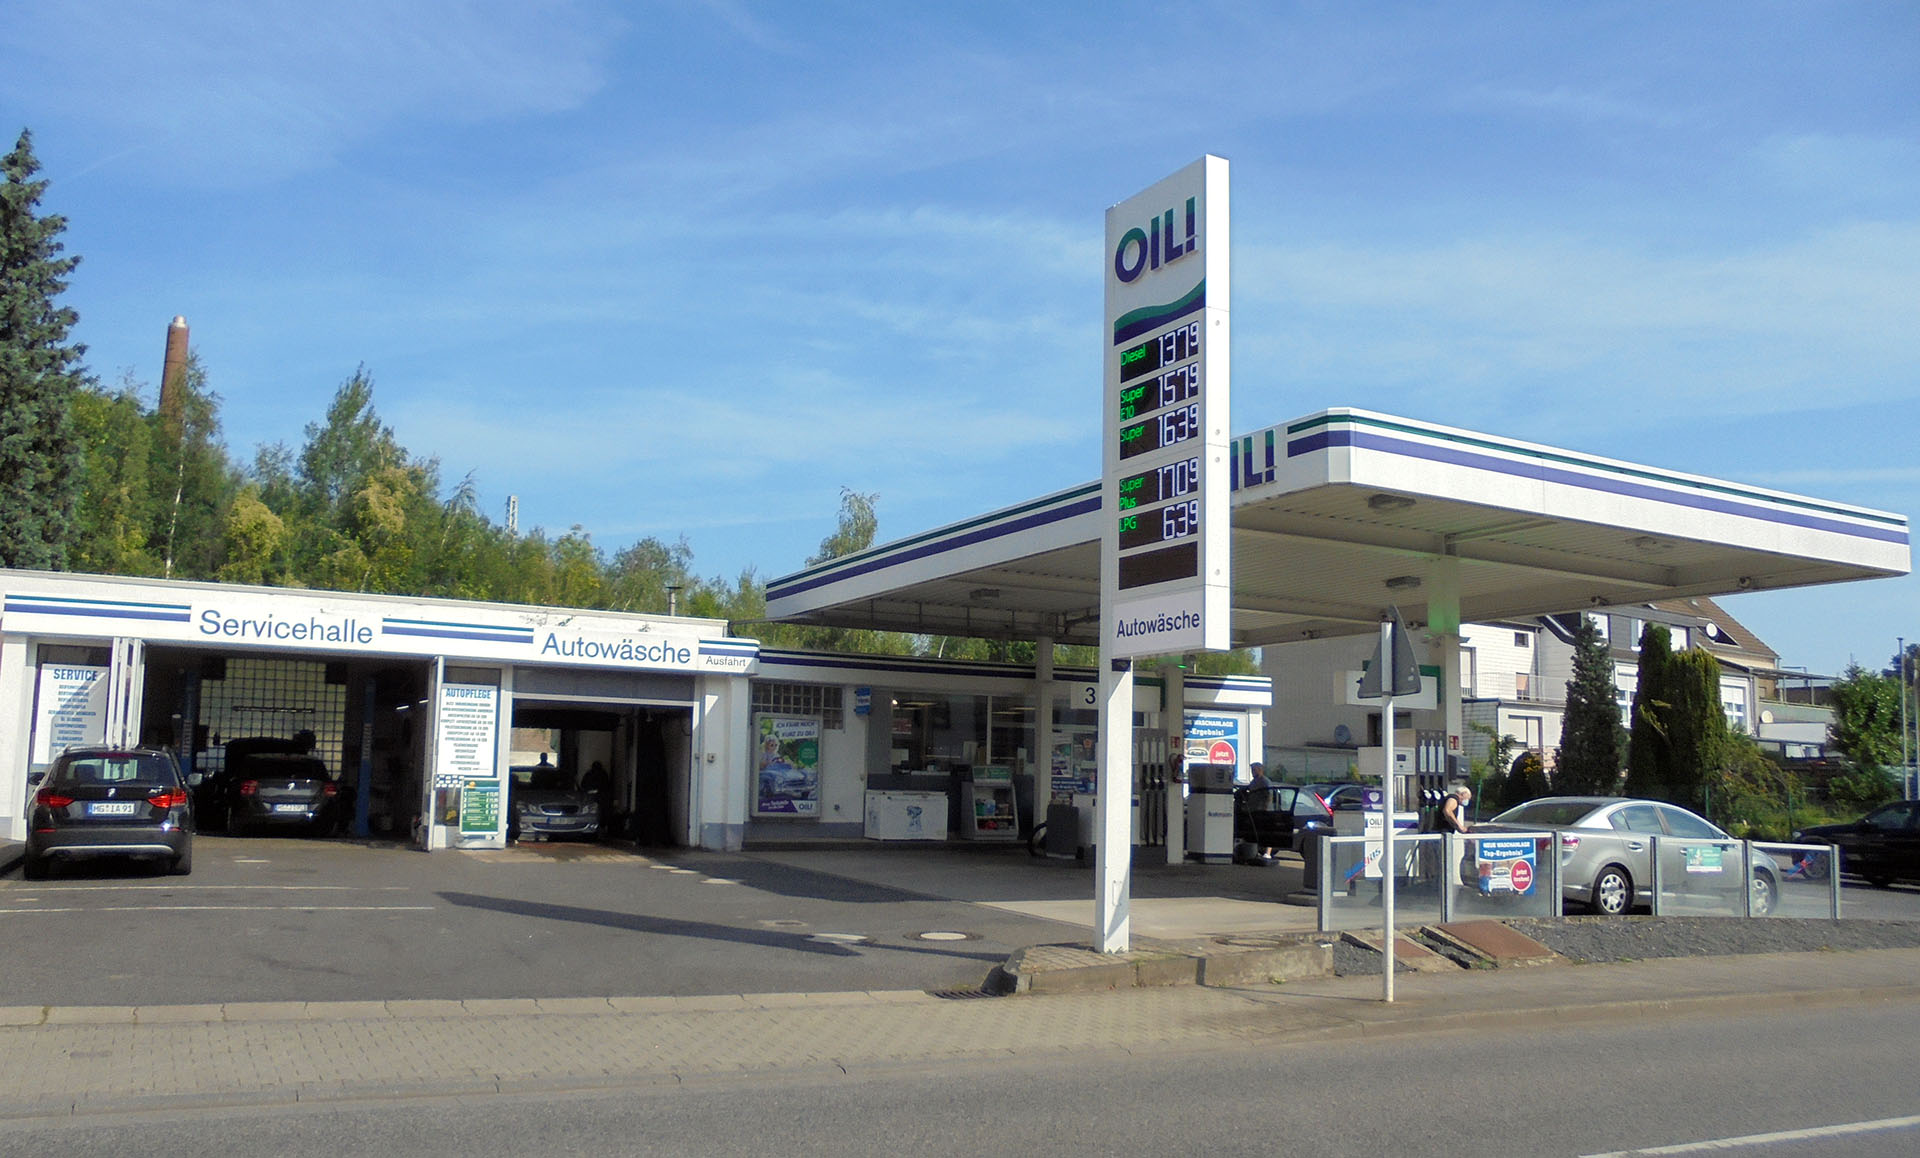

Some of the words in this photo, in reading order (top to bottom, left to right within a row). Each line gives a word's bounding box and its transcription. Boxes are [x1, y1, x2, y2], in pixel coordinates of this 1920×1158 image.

[1115, 196, 1196, 283] OIL!
[1121, 343, 1146, 366] Diesel
[1158, 321, 1199, 368] 1379
[1121, 386, 1145, 404] Super
[1158, 362, 1199, 407] 1579
[1120, 404, 1135, 421] E10
[1120, 426, 1145, 442] Super
[1158, 404, 1199, 448] 1639
[1230, 430, 1275, 492] IL!
[1120, 477, 1145, 493] Super
[1157, 458, 1199, 500] 1709
[1120, 497, 1136, 511] Plus
[1119, 516, 1137, 532] LPG
[1163, 500, 1199, 540] 639
[199, 609, 373, 644] Servicehalle
[1117, 611, 1200, 638] Autowäsche
[541, 633, 691, 664] Autowäsche
[705, 656, 747, 667] Ausfahrt
[53, 668, 98, 681] SERVICE
[446, 688, 491, 699] AUTOPFLEGE
[1085, 687, 1096, 704] 3
